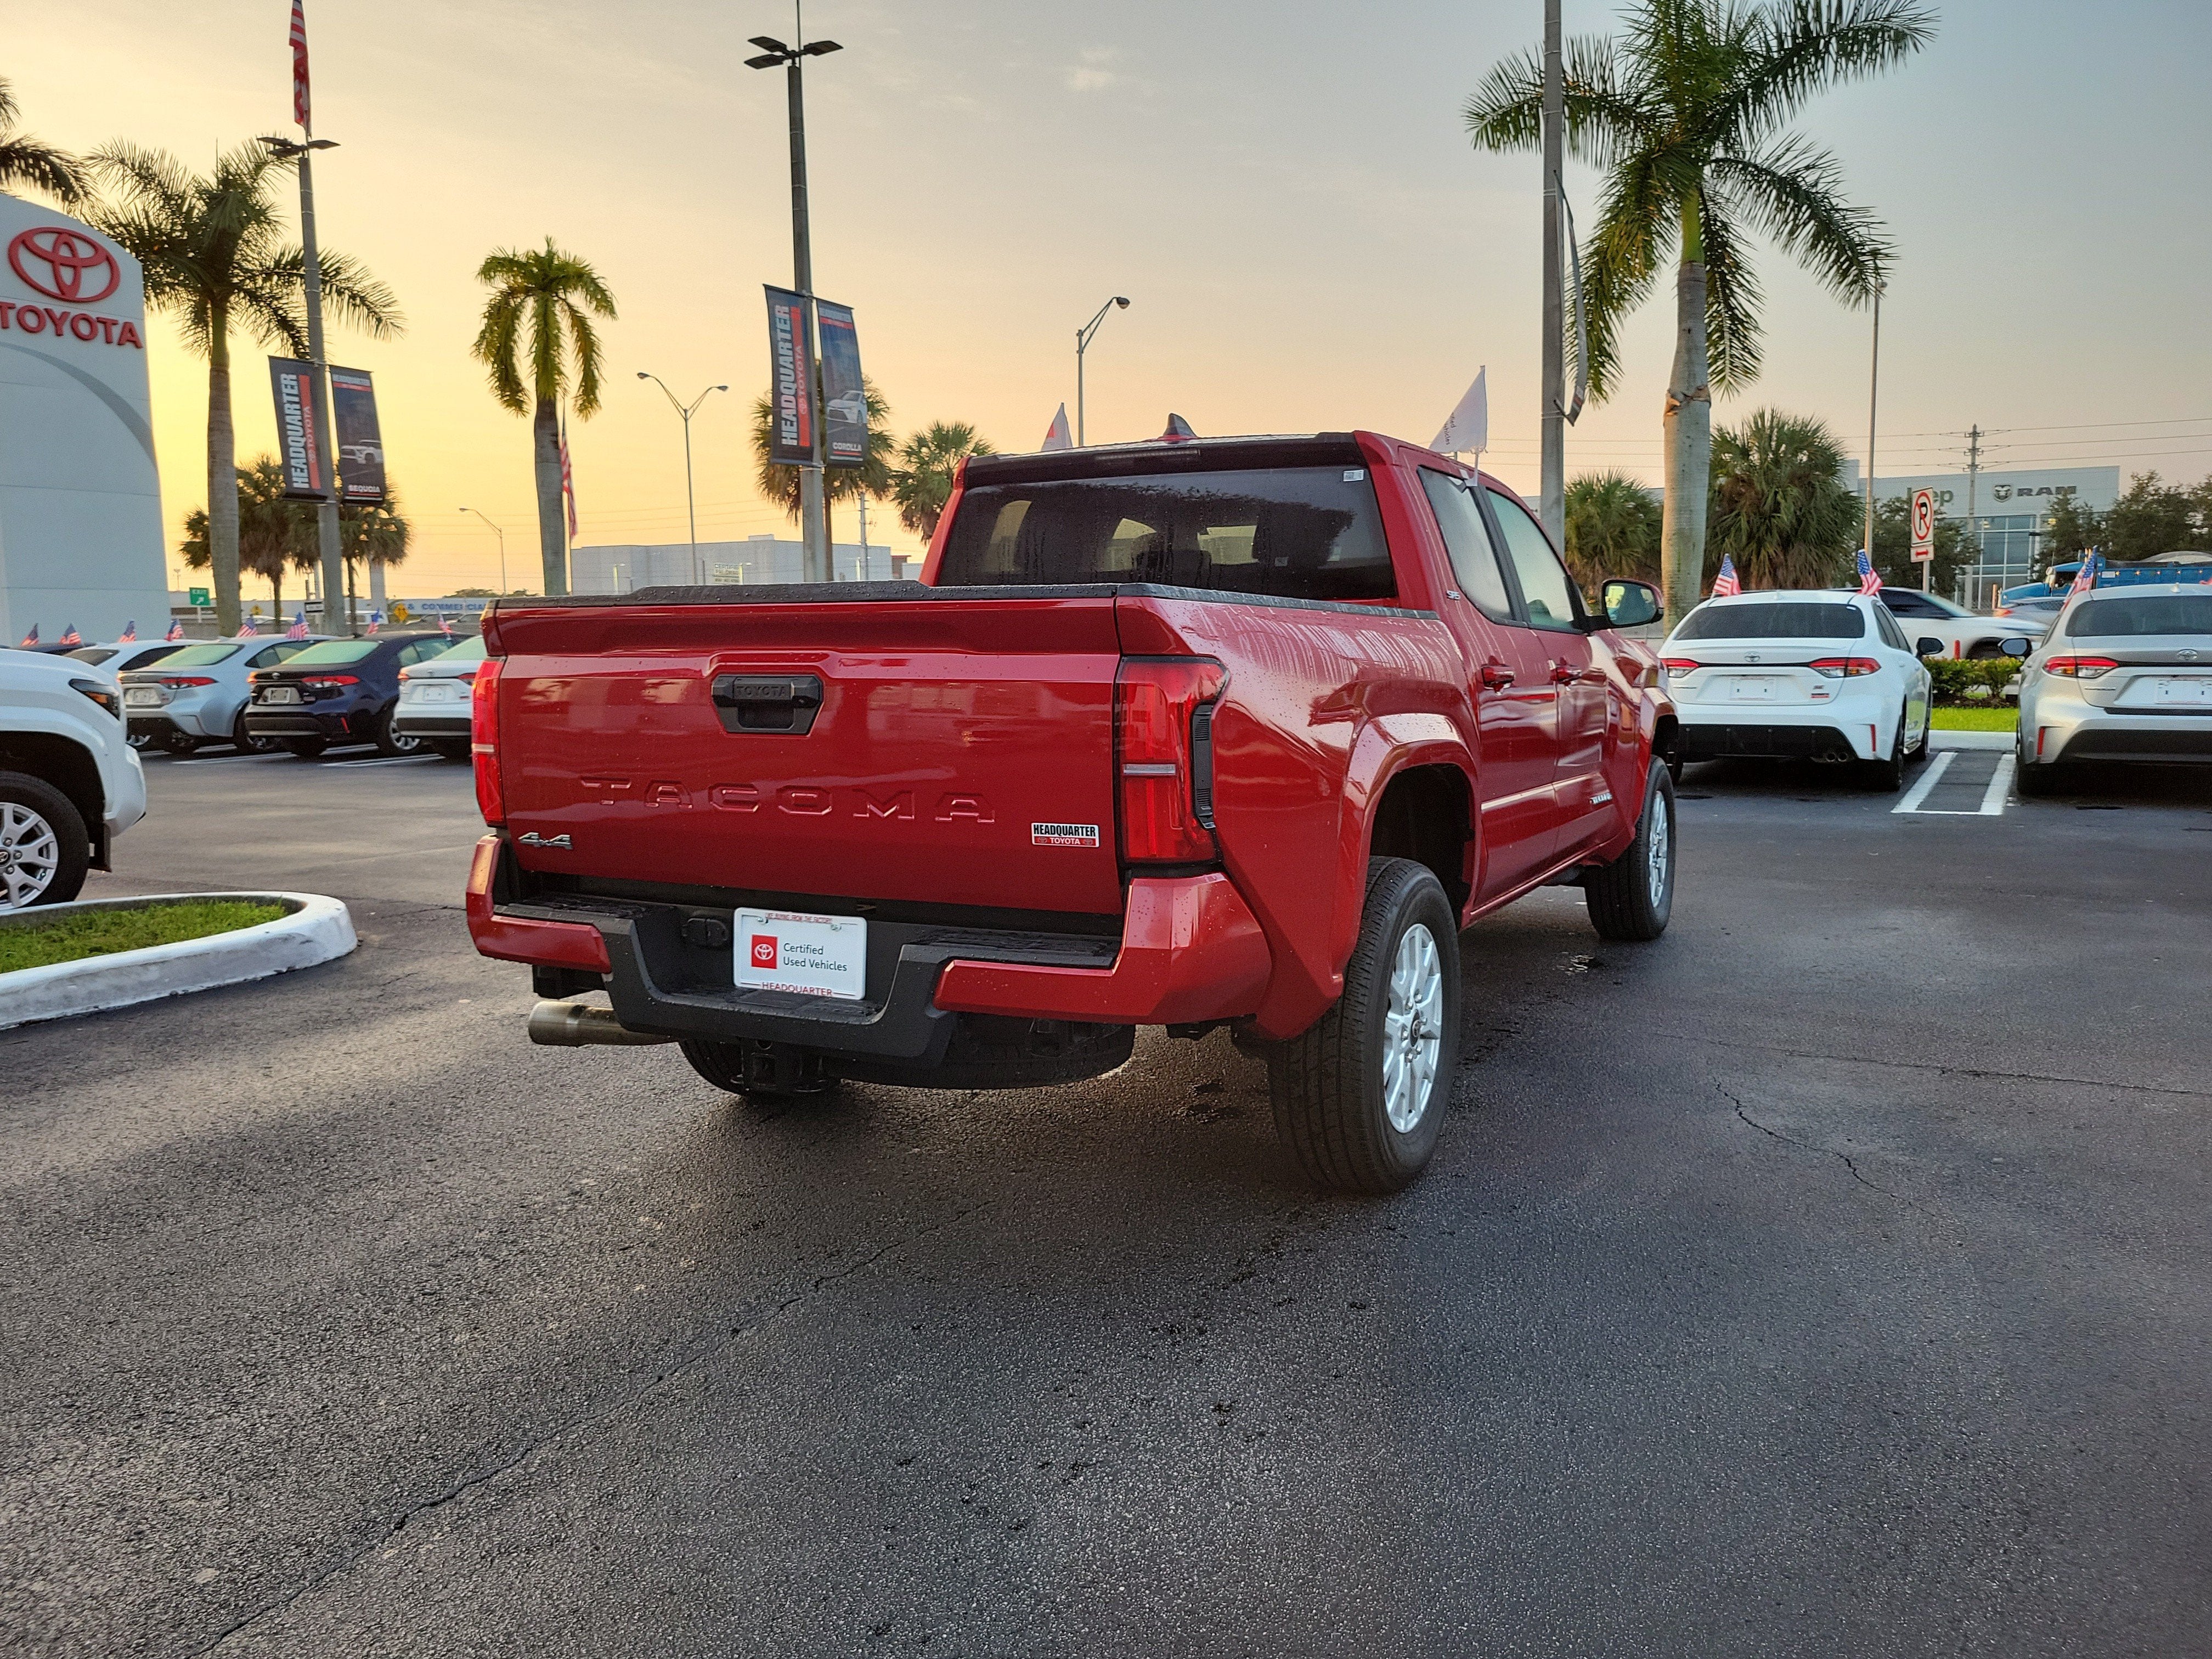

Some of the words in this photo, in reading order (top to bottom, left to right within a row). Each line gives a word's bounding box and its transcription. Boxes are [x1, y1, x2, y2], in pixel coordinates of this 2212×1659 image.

[0, 302, 143, 348] TOYOTA
[775, 305, 798, 445] HEADQUARTER
[280, 374, 310, 488] HEADQUARTER
[832, 442, 862, 452] COROLLA
[348, 484, 381, 493] SEQUOIA
[2017, 486, 2076, 497] RAM
[736, 686, 788, 698] TOYOTA
[580, 777, 995, 823] TACOMA
[1033, 824, 1096, 837] HEADQUARTER
[1050, 837, 1081, 845] TOYOTA
[783, 943, 824, 955] Certified
[783, 956, 806, 967] Used
[809, 959, 848, 972] Vehicles
[762, 981, 832, 996] HEADQUARTER
